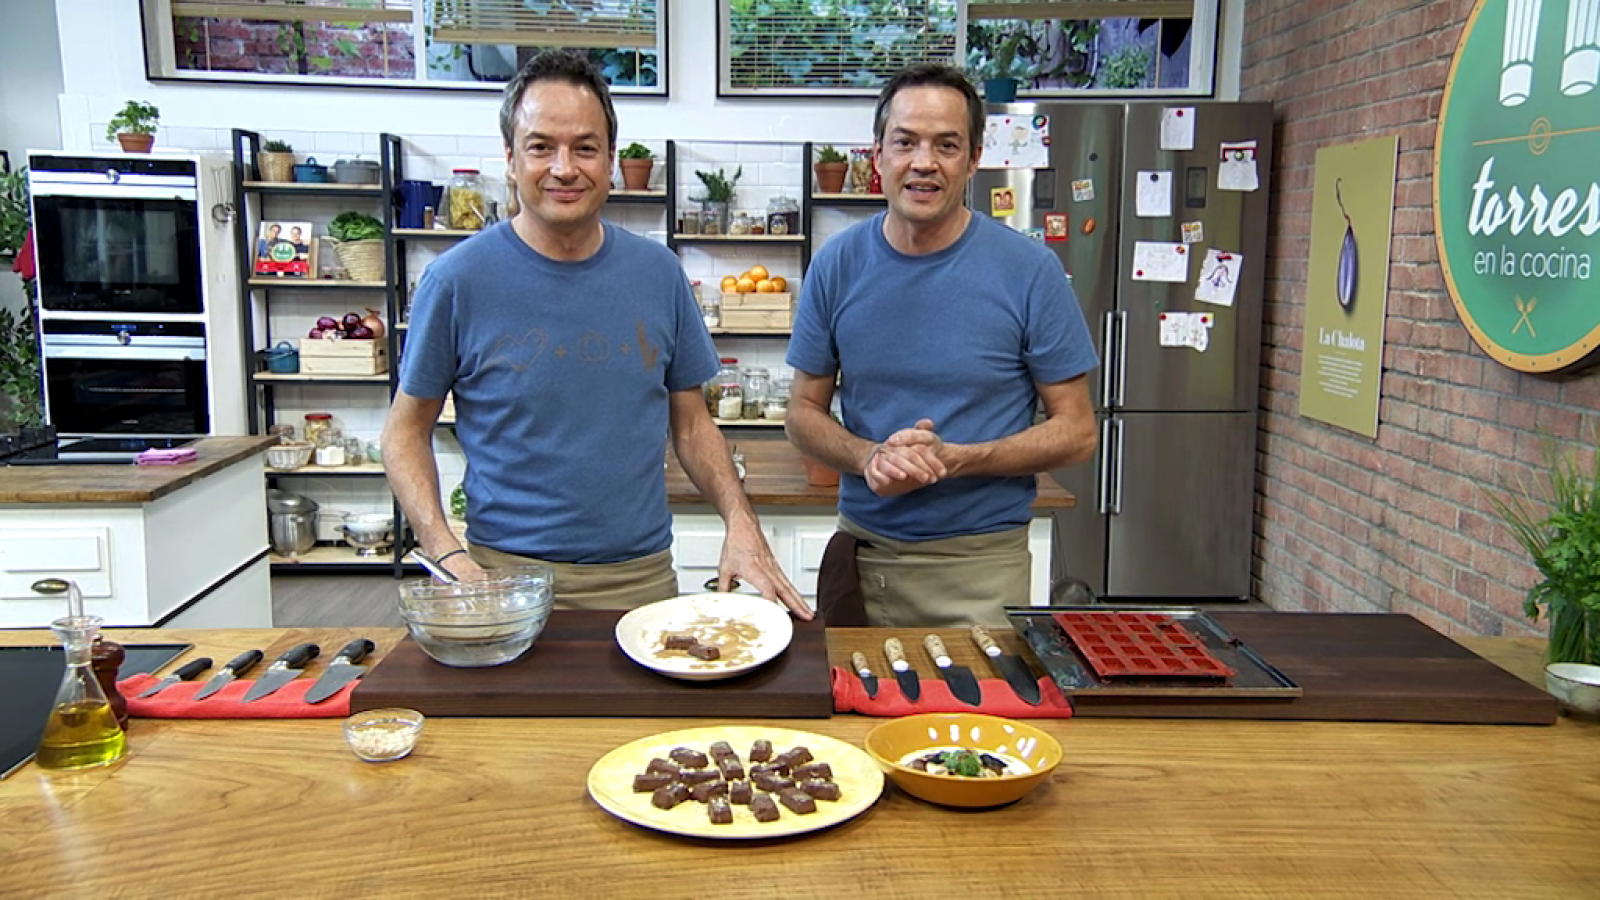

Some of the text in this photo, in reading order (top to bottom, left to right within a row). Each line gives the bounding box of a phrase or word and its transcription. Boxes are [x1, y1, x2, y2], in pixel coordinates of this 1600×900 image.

[1468, 155, 1600, 237] torres
[1474, 244, 1591, 279] en la cocina
[1319, 327, 1331, 345] La
